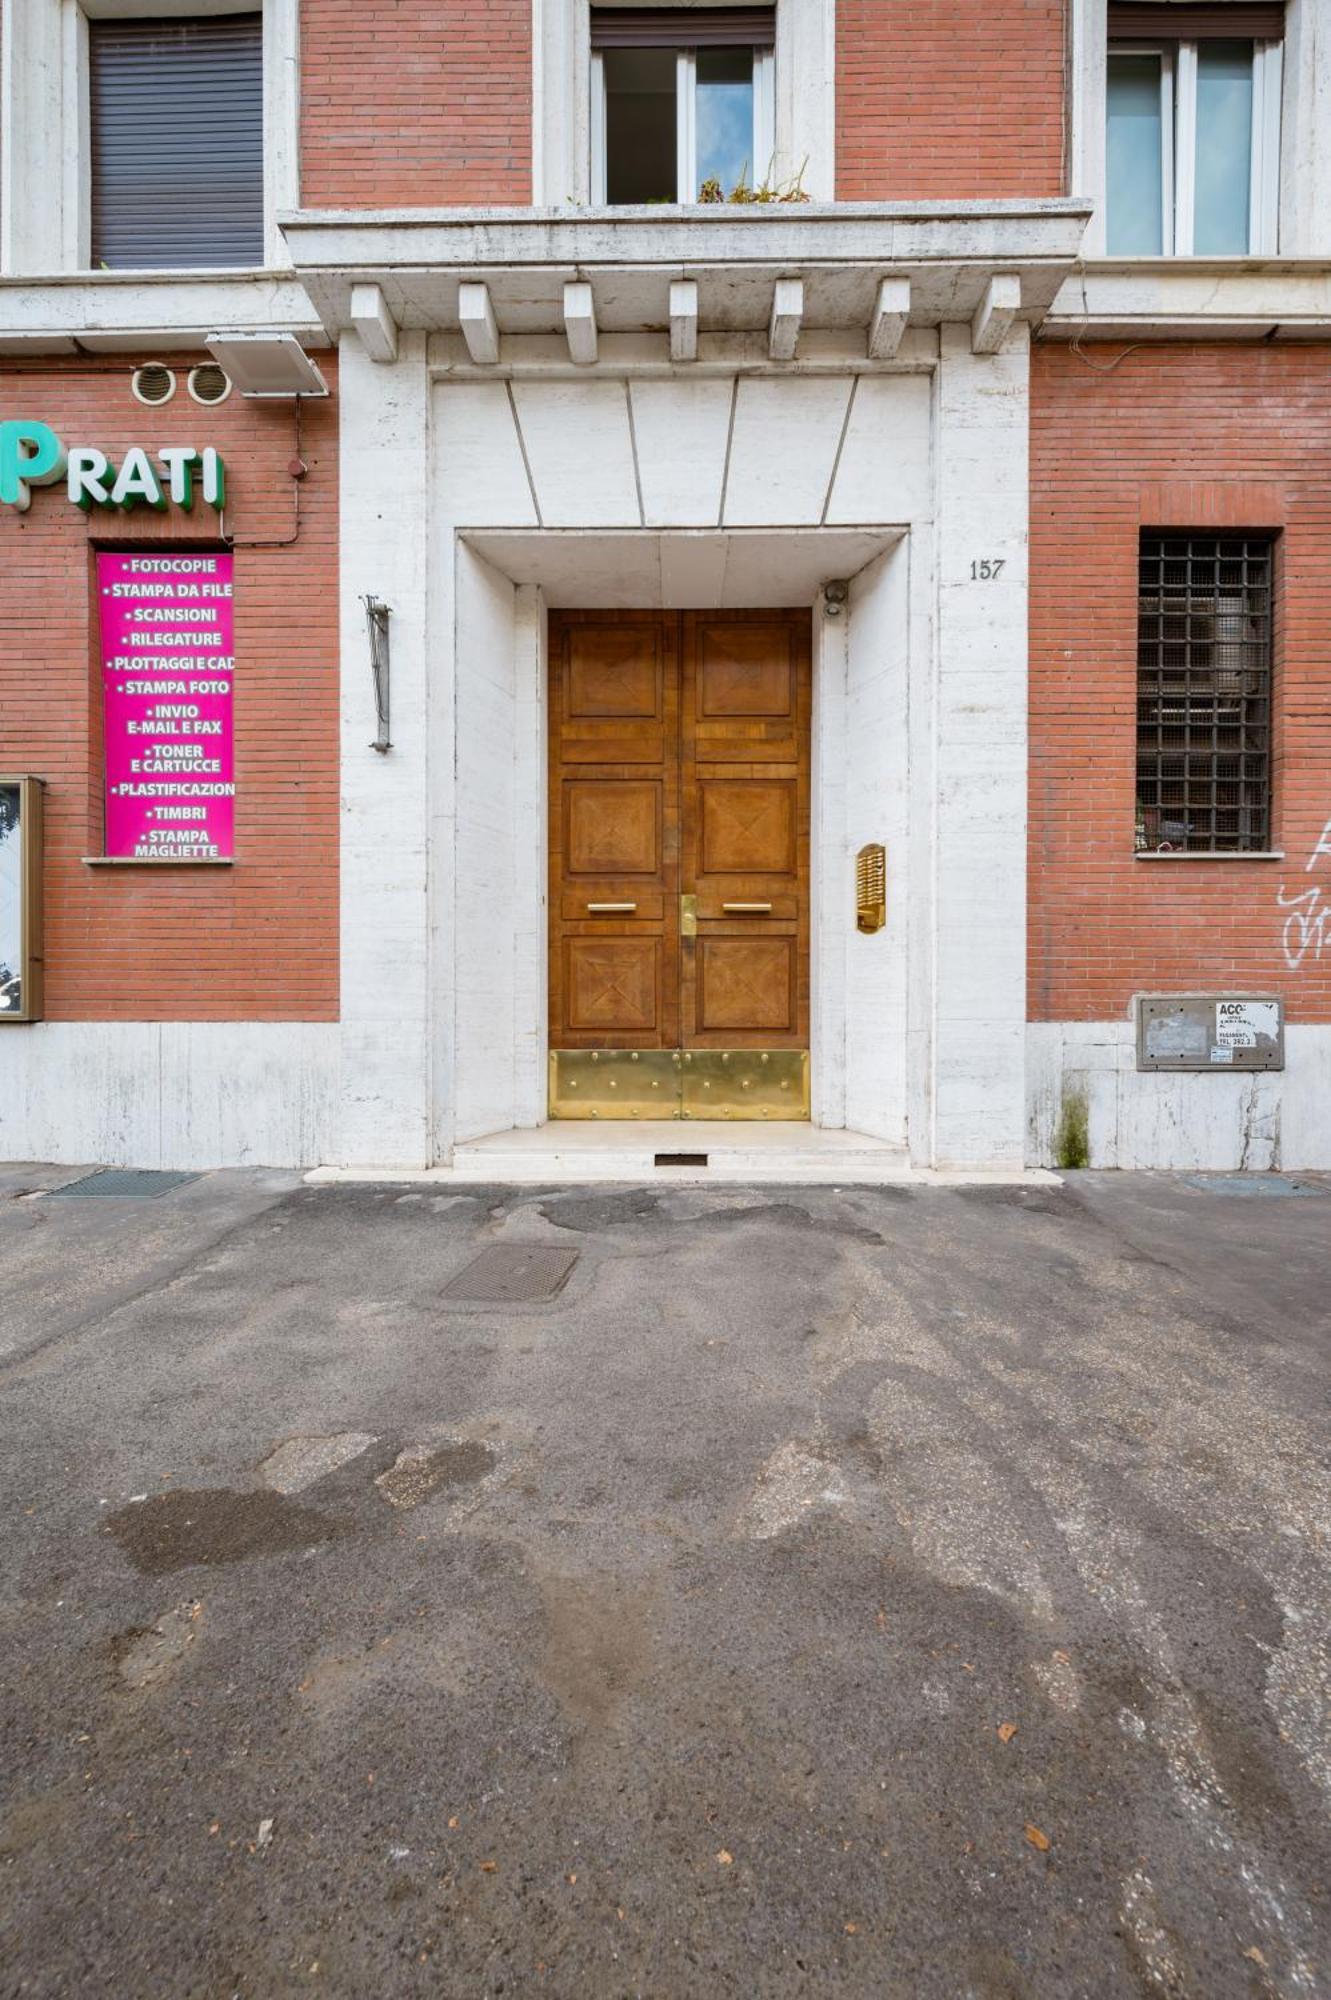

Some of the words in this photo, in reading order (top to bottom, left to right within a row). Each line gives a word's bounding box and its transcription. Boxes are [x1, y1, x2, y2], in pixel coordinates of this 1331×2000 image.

[0, 420, 220, 506] PRATI
[131, 559, 216, 572] FOTOCOPIE
[970, 559, 1006, 580] 157
[112, 584, 174, 597] STAMPA
[177, 584, 199, 597] DA
[202, 584, 233, 597] FILE
[134, 608, 216, 621] SCANSIONI
[131, 633, 222, 646] RILEGATURE
[114, 657, 194, 670] PLOTTAGGI
[197, 657, 205, 670] E
[126, 681, 186, 694] STAMPA
[190, 681, 229, 694] FOTO
[155, 705, 198, 718] INVIO
[127, 721, 179, 734] E-MAIL
[182, 721, 191, 734] E
[194, 721, 222, 734] FAX
[152, 745, 204, 758] TONER
[131, 760, 140, 772] E
[143, 759, 221, 772] CARTUCCE
[153, 807, 207, 819] TIMBRI
[149, 830, 209, 842] STAMPA
[134, 845, 218, 857] MAGLIETTE
